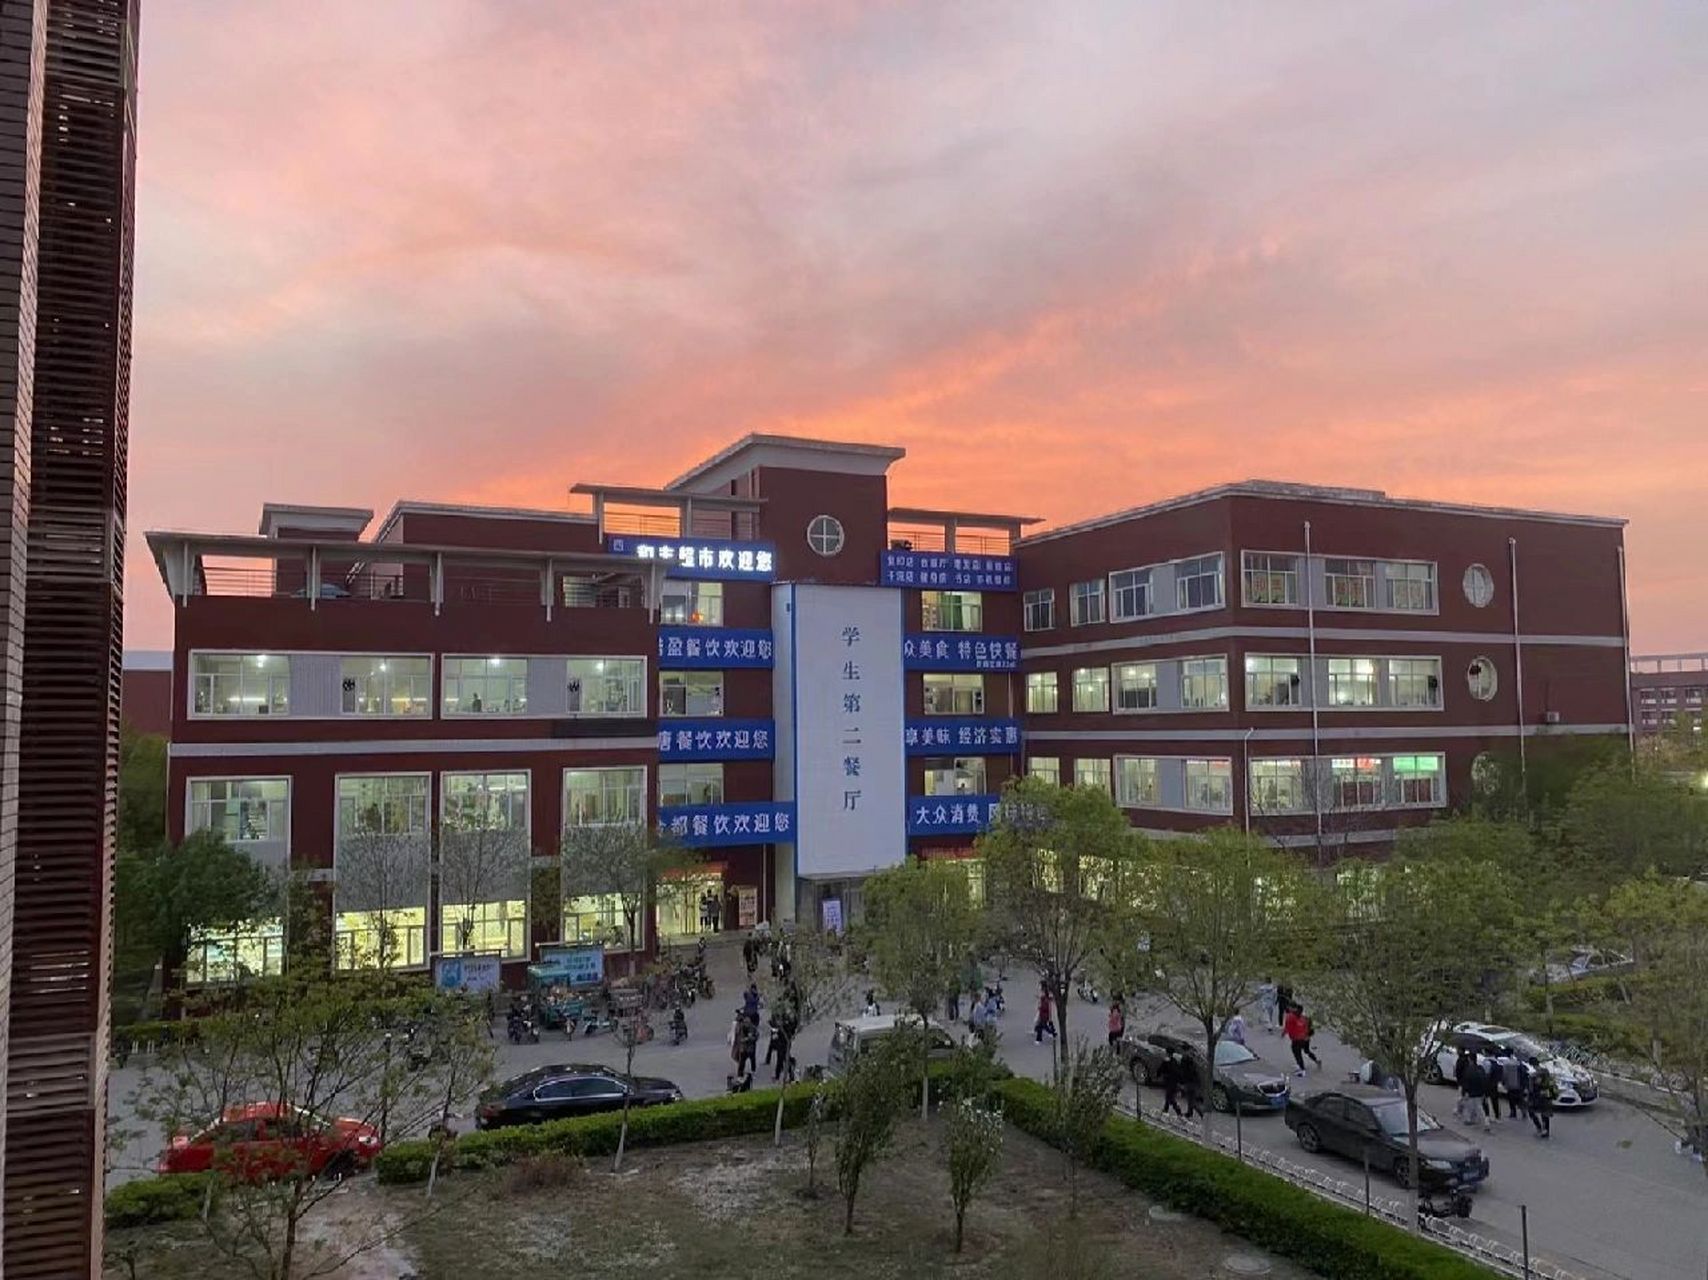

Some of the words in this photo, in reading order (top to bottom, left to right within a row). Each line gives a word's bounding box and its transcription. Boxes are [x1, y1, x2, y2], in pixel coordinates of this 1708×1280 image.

[841, 626, 862, 811] 学生第二餐厅
[958, 726, 1018, 745] 经济实惠
[916, 803, 981, 825] 大众消费
